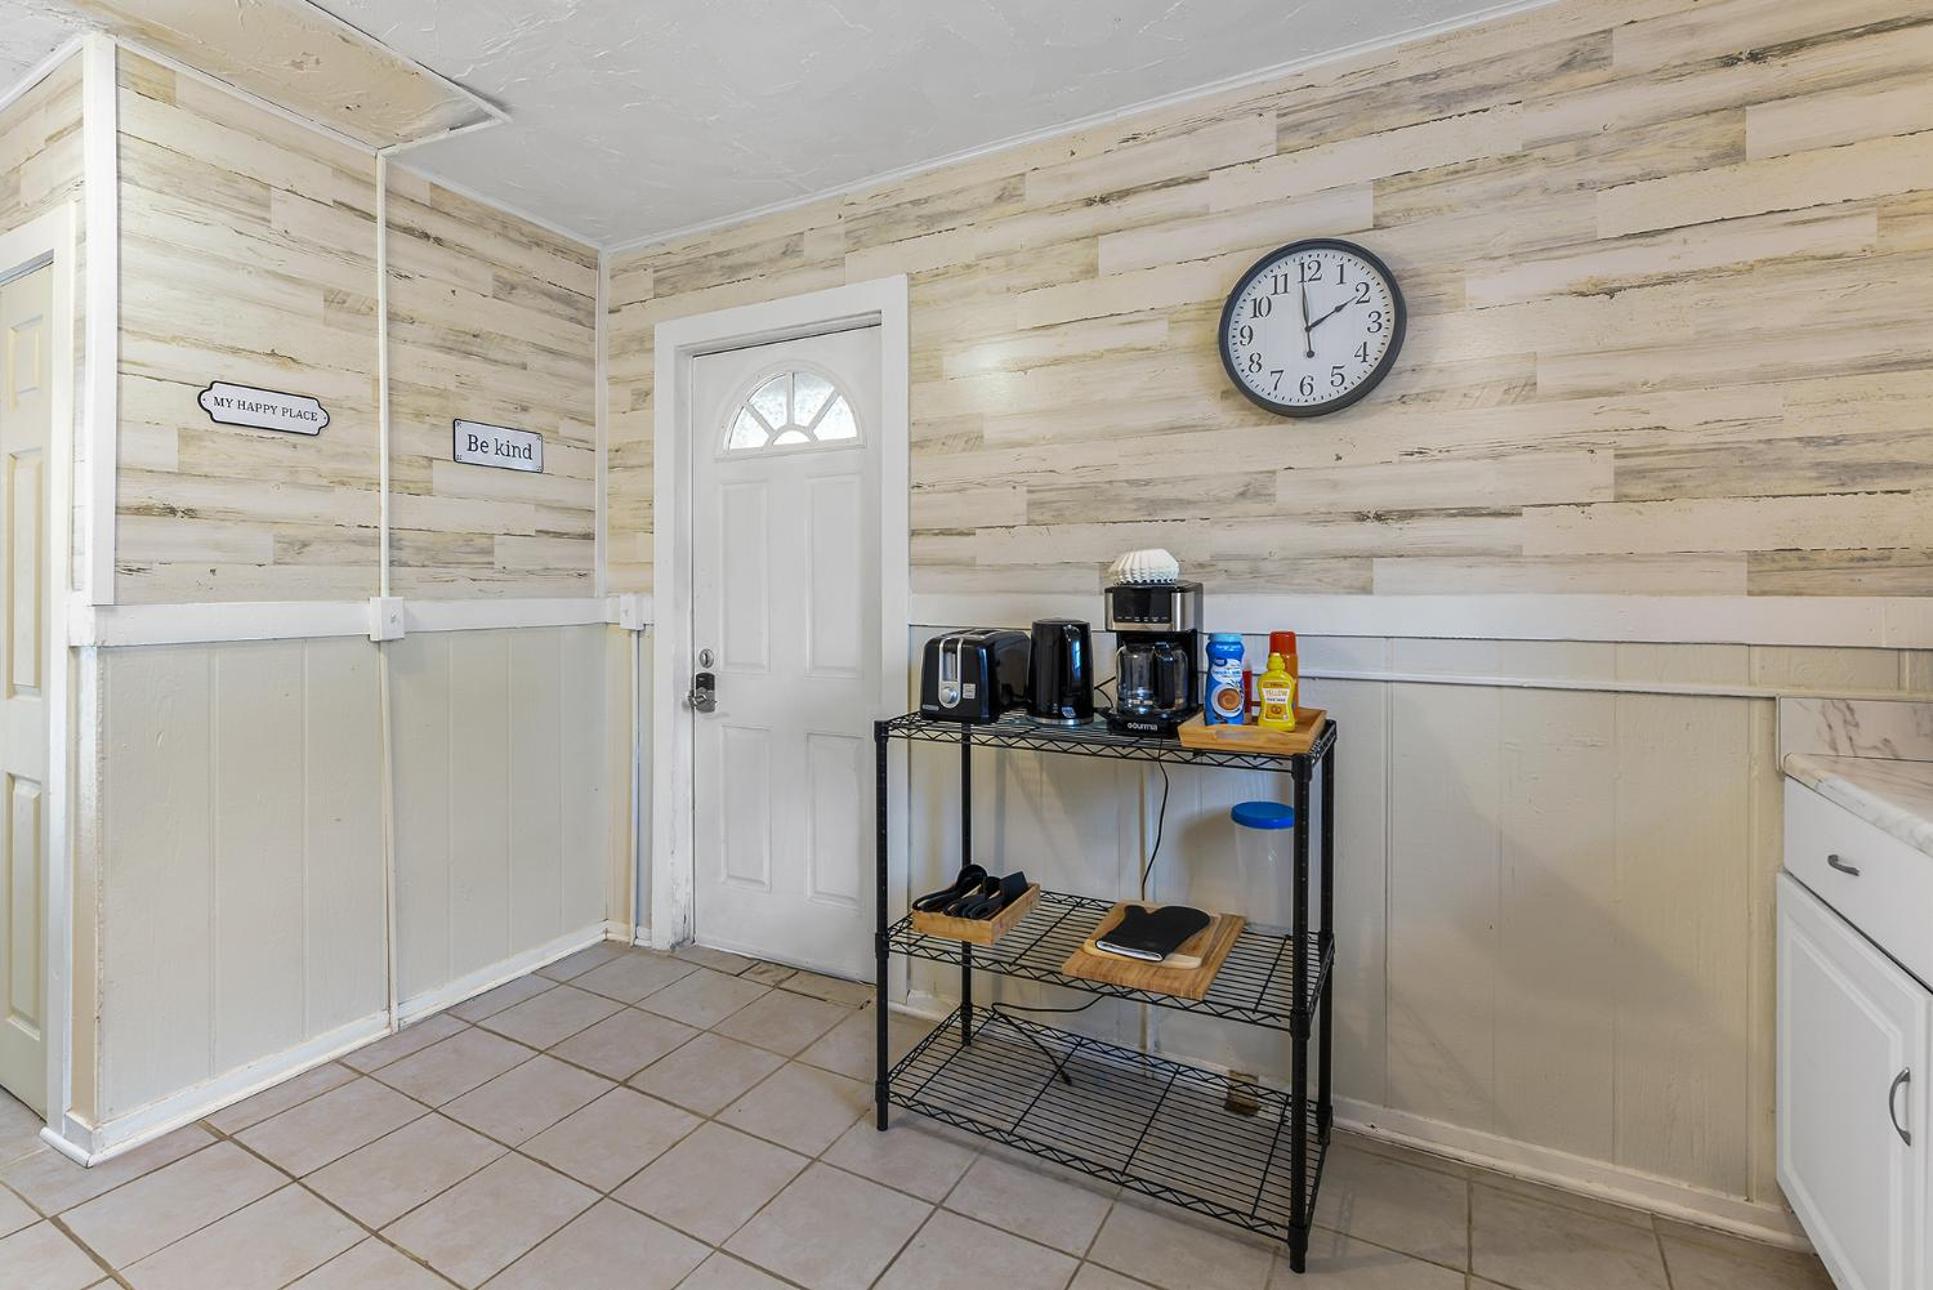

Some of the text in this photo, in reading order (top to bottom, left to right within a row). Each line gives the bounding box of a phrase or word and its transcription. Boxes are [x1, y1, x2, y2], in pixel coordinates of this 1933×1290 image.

[1298, 260, 1323, 283] 12
[1336, 263, 1346, 285] 1
[1271, 273, 1289, 296] 11
[1355, 282, 1371, 305] 2
[1250, 296, 1272, 319] 10
[1367, 311, 1382, 333] 3
[1239, 325, 1253, 346] 9
[1249, 352, 1262, 374] 8
[1354, 341, 1369, 363] 4
[1270, 370, 1284, 391] 7
[1300, 375, 1314, 396] 6
[1330, 364, 1346, 387] 5
[213, 396, 318, 422] MY HAPPY PLACE
[467, 434, 533, 460] Be kind
